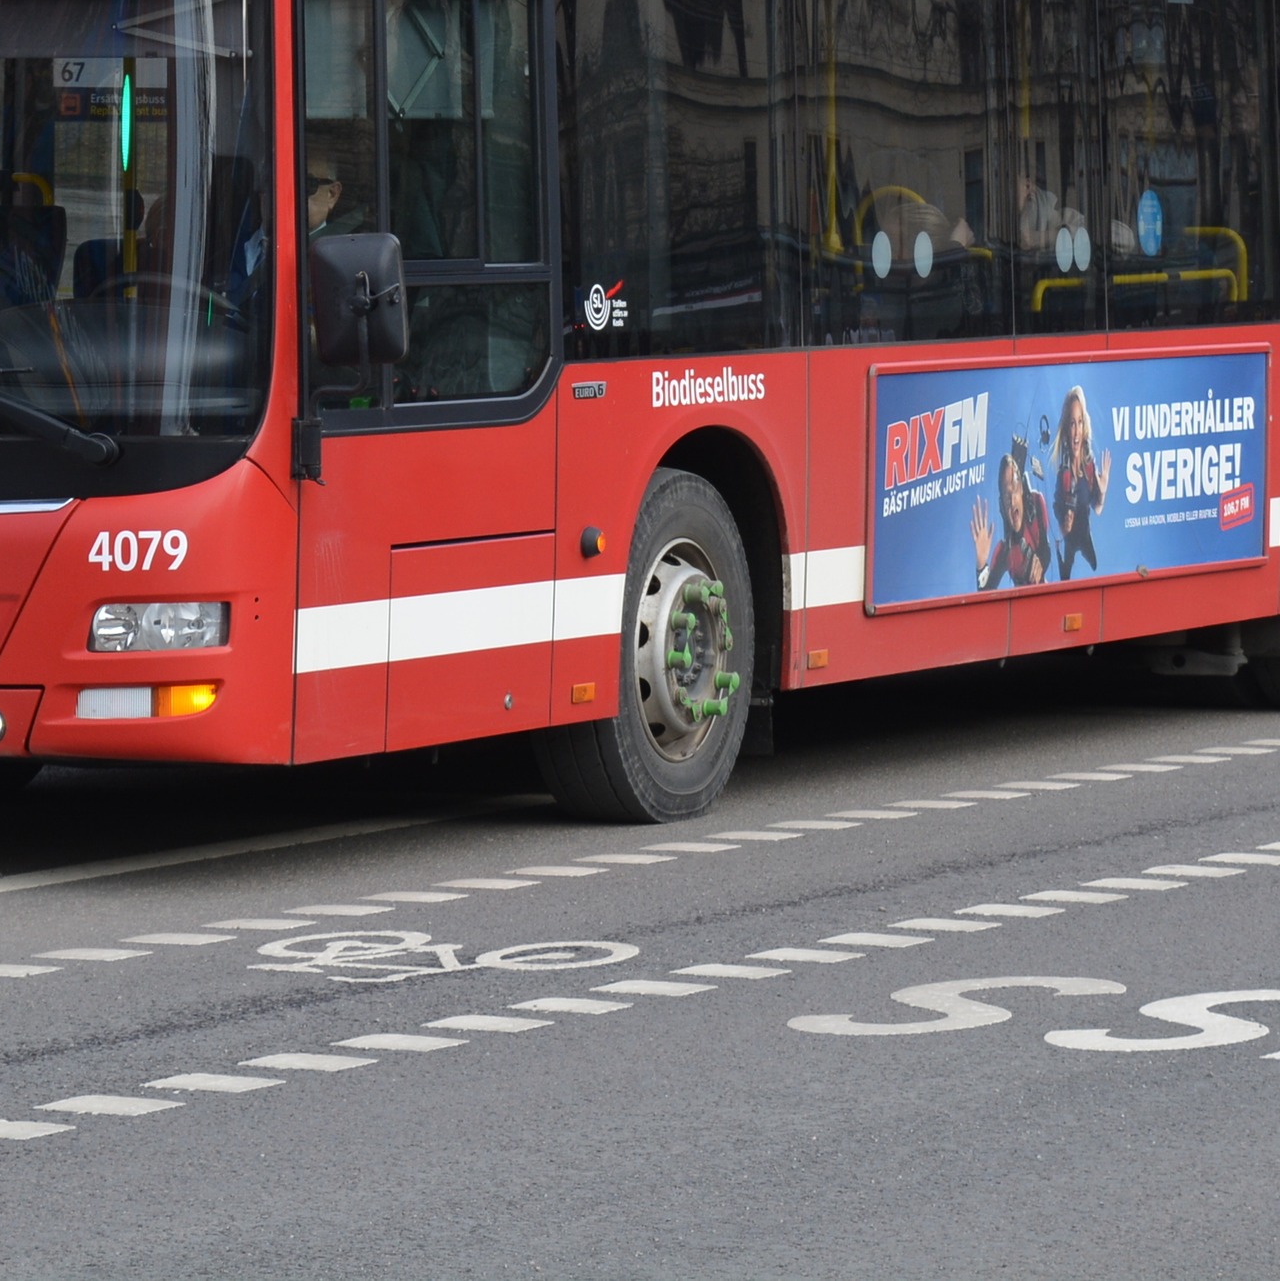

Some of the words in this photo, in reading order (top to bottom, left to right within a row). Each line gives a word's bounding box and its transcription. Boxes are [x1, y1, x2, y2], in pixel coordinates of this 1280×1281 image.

[61, 61, 86, 83] 67
[592, 293, 603, 309] SL
[574, 386, 596, 399] EURO
[597, 382, 605, 397] 6
[651, 365, 766, 408] Biodieselbuss
[1112, 406, 1130, 442] VI
[1134, 388, 1255, 441] UNDERHÅLLER
[1125, 442, 1242, 505] SVERIGE!
[882, 490, 909, 518] BÄST
[910, 477, 943, 508] MUSIK
[943, 469, 968, 496] JUST
[968, 462, 986, 487] NU!
[1223, 499, 1239, 517] 106,7
[1240, 495, 1250, 510] FM
[1124, 517, 1141, 529] LYSSNA
[1166, 511, 1185, 523] MOBILEN
[1185, 509, 1199, 522] ELLER
[87, 528, 189, 572] 4079
